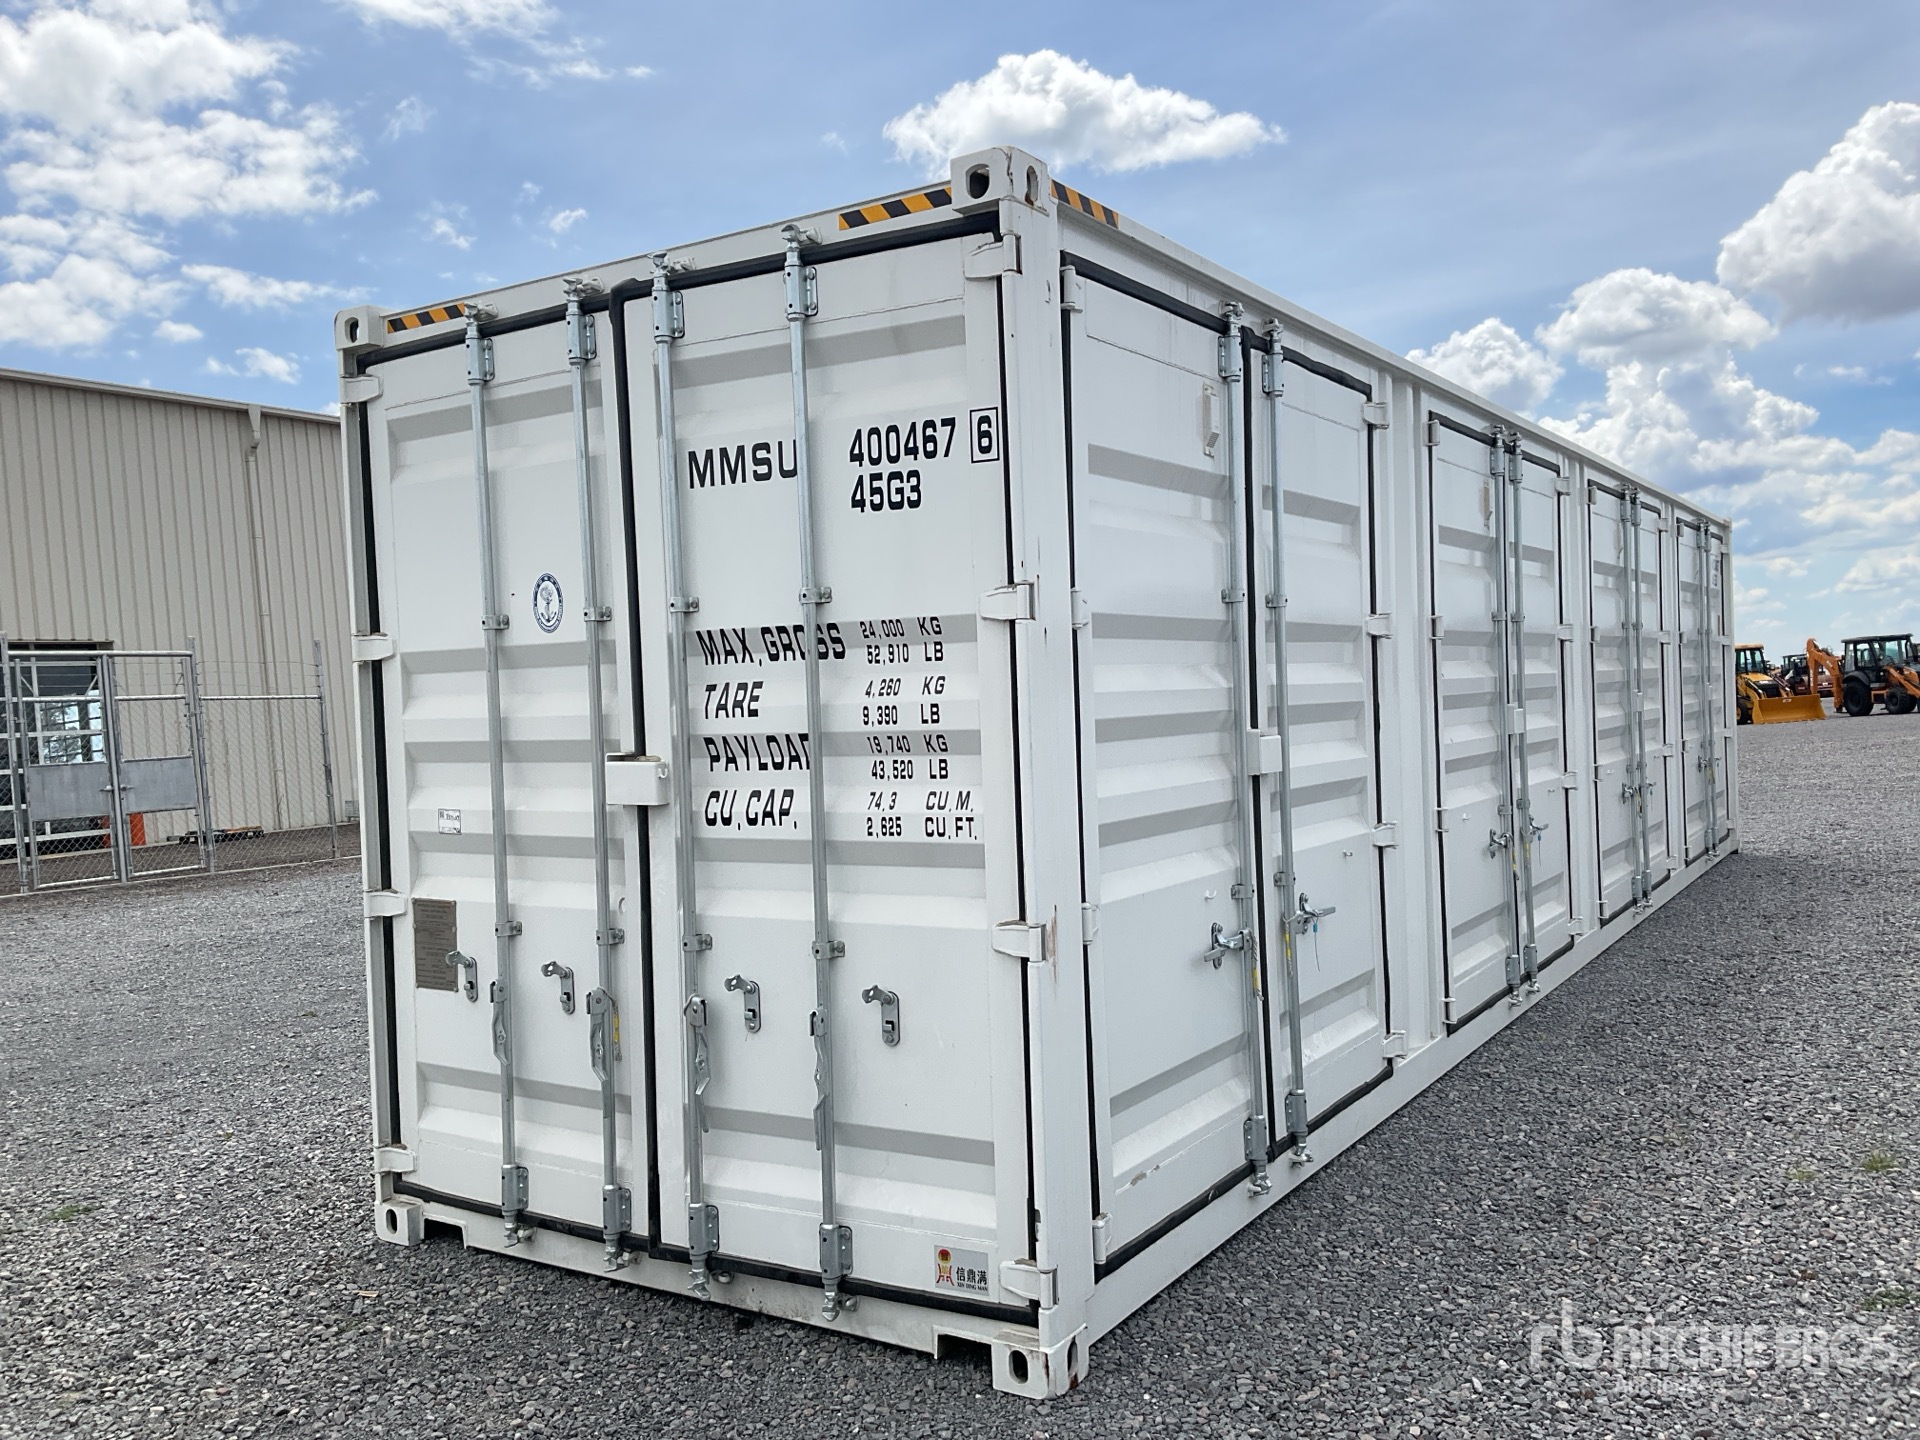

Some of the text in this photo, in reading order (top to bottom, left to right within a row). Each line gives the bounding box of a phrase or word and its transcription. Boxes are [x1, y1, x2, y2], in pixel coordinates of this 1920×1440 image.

[689, 414, 993, 490] MMSU 400467 6
[850, 469, 922, 513] 45G3
[860, 618, 905, 640] 24,000
[917, 616, 943, 636] KG
[866, 641, 944, 665] 52,910 LB
[704, 675, 946, 720] TARE 4,260 KG
[862, 703, 940, 727] 9,390 LB
[866, 735, 911, 756] 19,740
[923, 733, 949, 753] KG
[871, 758, 949, 781] 43,520 LB
[867, 791, 898, 812] 74.3
[866, 816, 902, 839] 2,625
